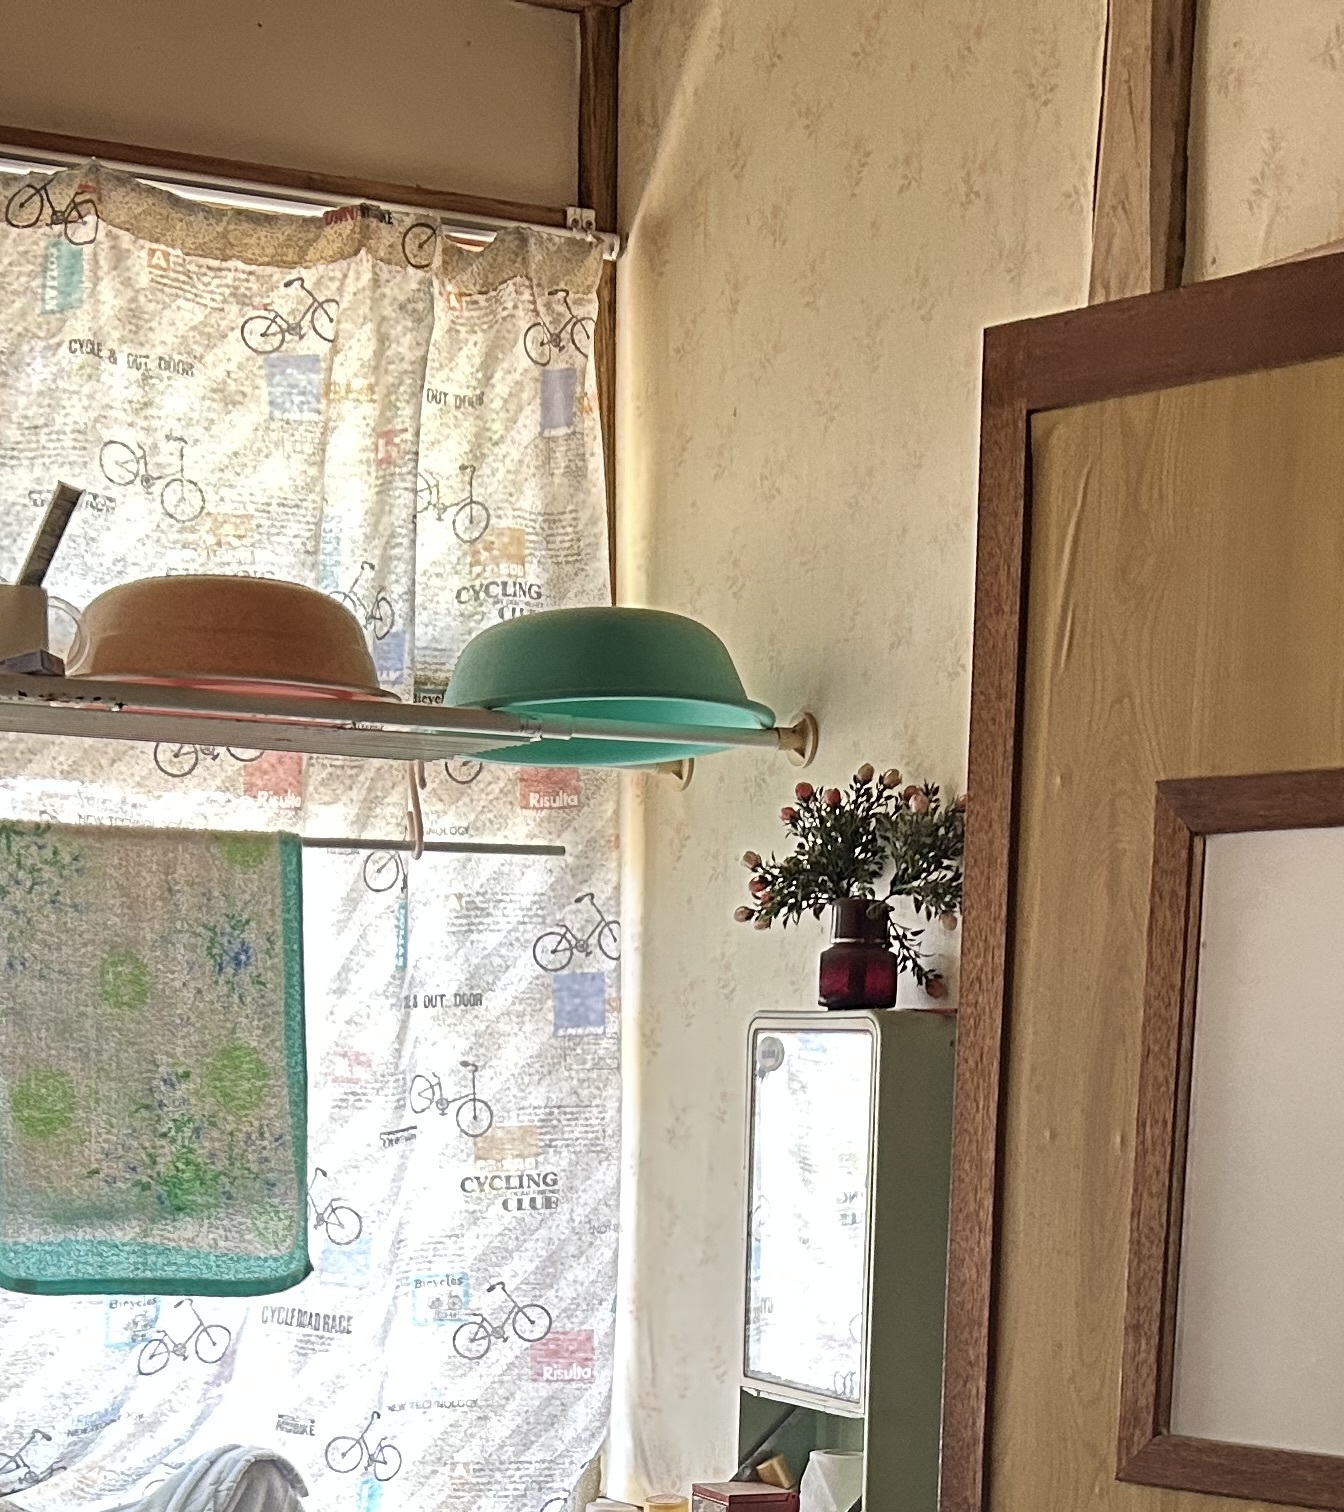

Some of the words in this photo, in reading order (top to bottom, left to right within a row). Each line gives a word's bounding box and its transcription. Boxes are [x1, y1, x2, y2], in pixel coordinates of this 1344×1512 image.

[68, 338, 104, 360] CYCLE
[455, 580, 543, 604] CYCLING
[528, 790, 580, 808] Risulta
[423, 994, 446, 1009] OUT
[455, 993, 484, 1008] DOOR
[459, 1171, 559, 1194] CYCLING
[501, 1195, 560, 1213] CLUB
[322, 1313, 354, 1335] RACE
[541, 1362, 593, 1381] Risulta
